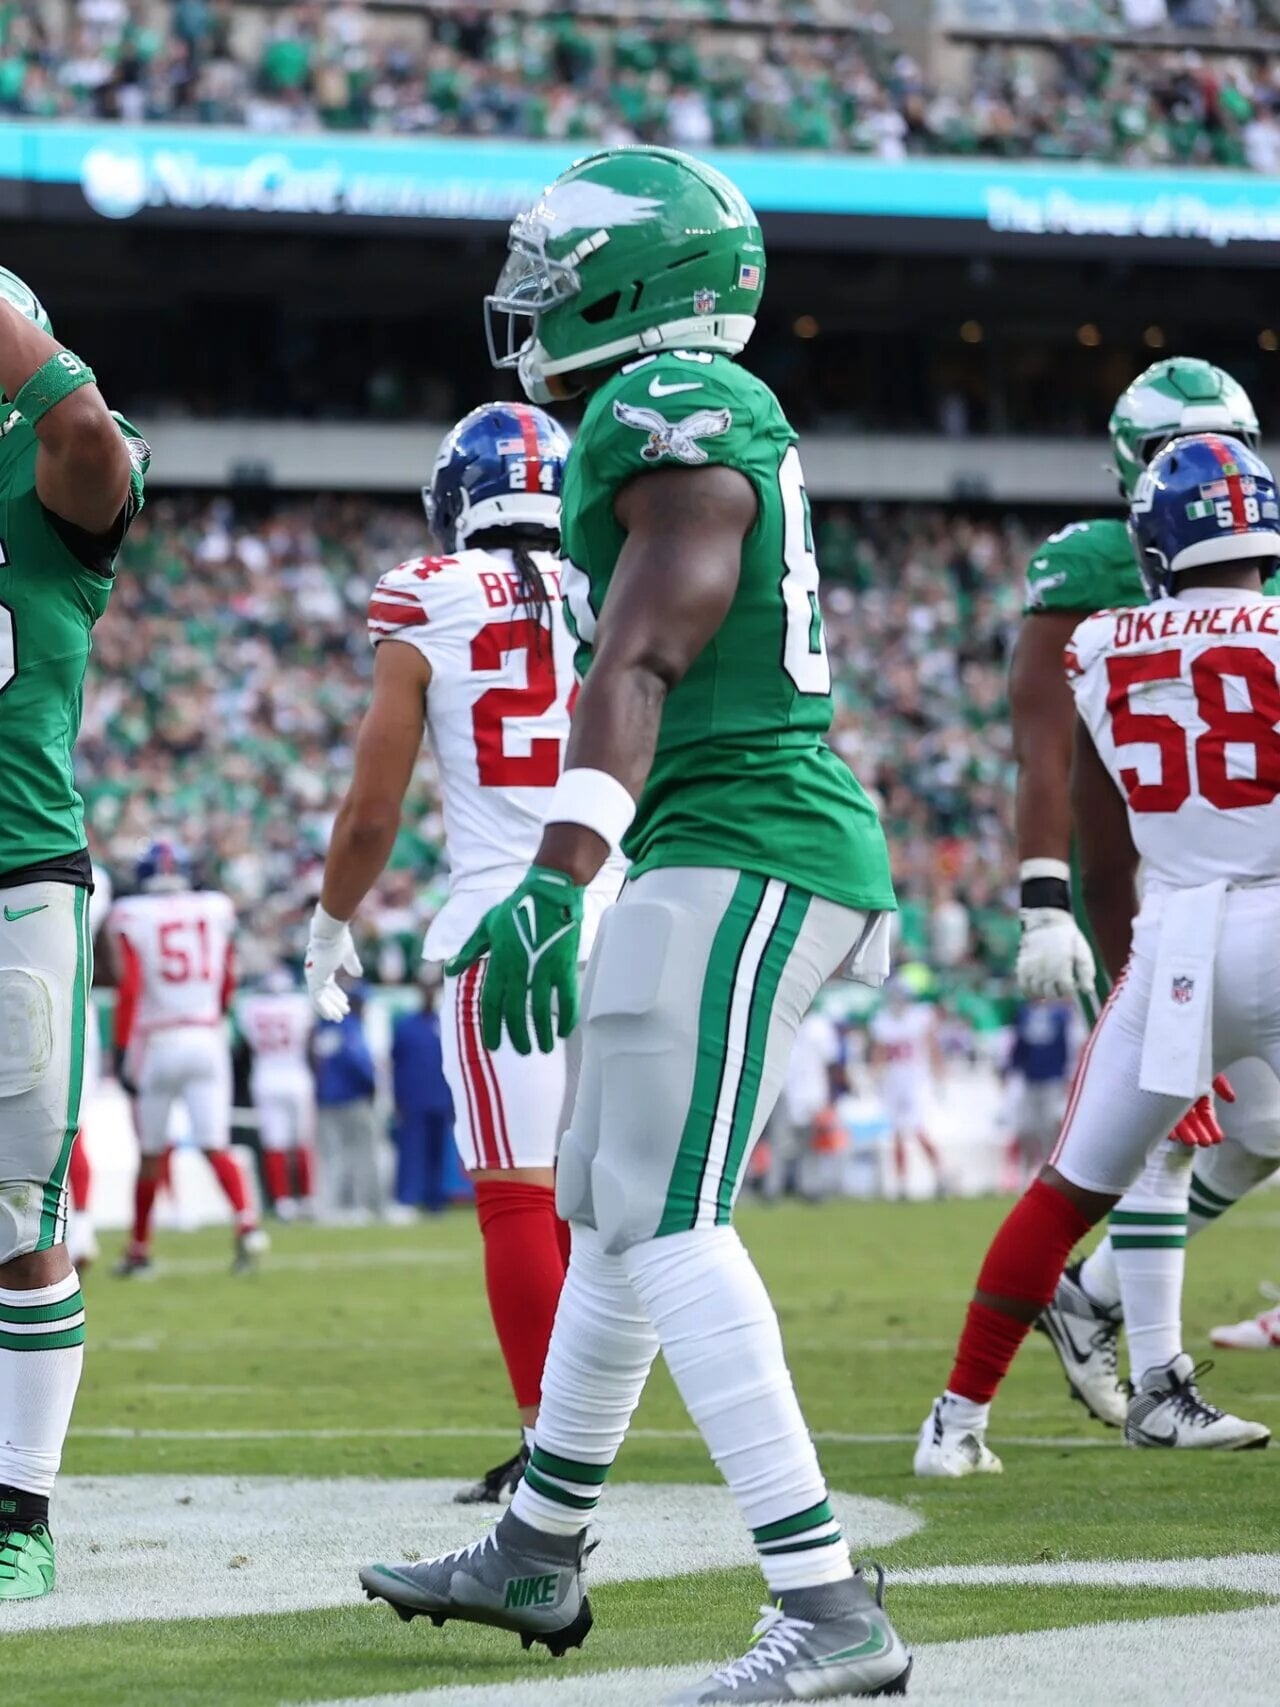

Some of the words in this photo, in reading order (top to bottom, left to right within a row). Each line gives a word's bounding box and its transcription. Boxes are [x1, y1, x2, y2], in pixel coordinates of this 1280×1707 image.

[1215, 496, 1261, 528] 58
[471, 617, 578, 787] 2
[1105, 645, 1280, 814] 58
[157, 918, 211, 984] 51
[504, 1573, 559, 1609] NIKE
